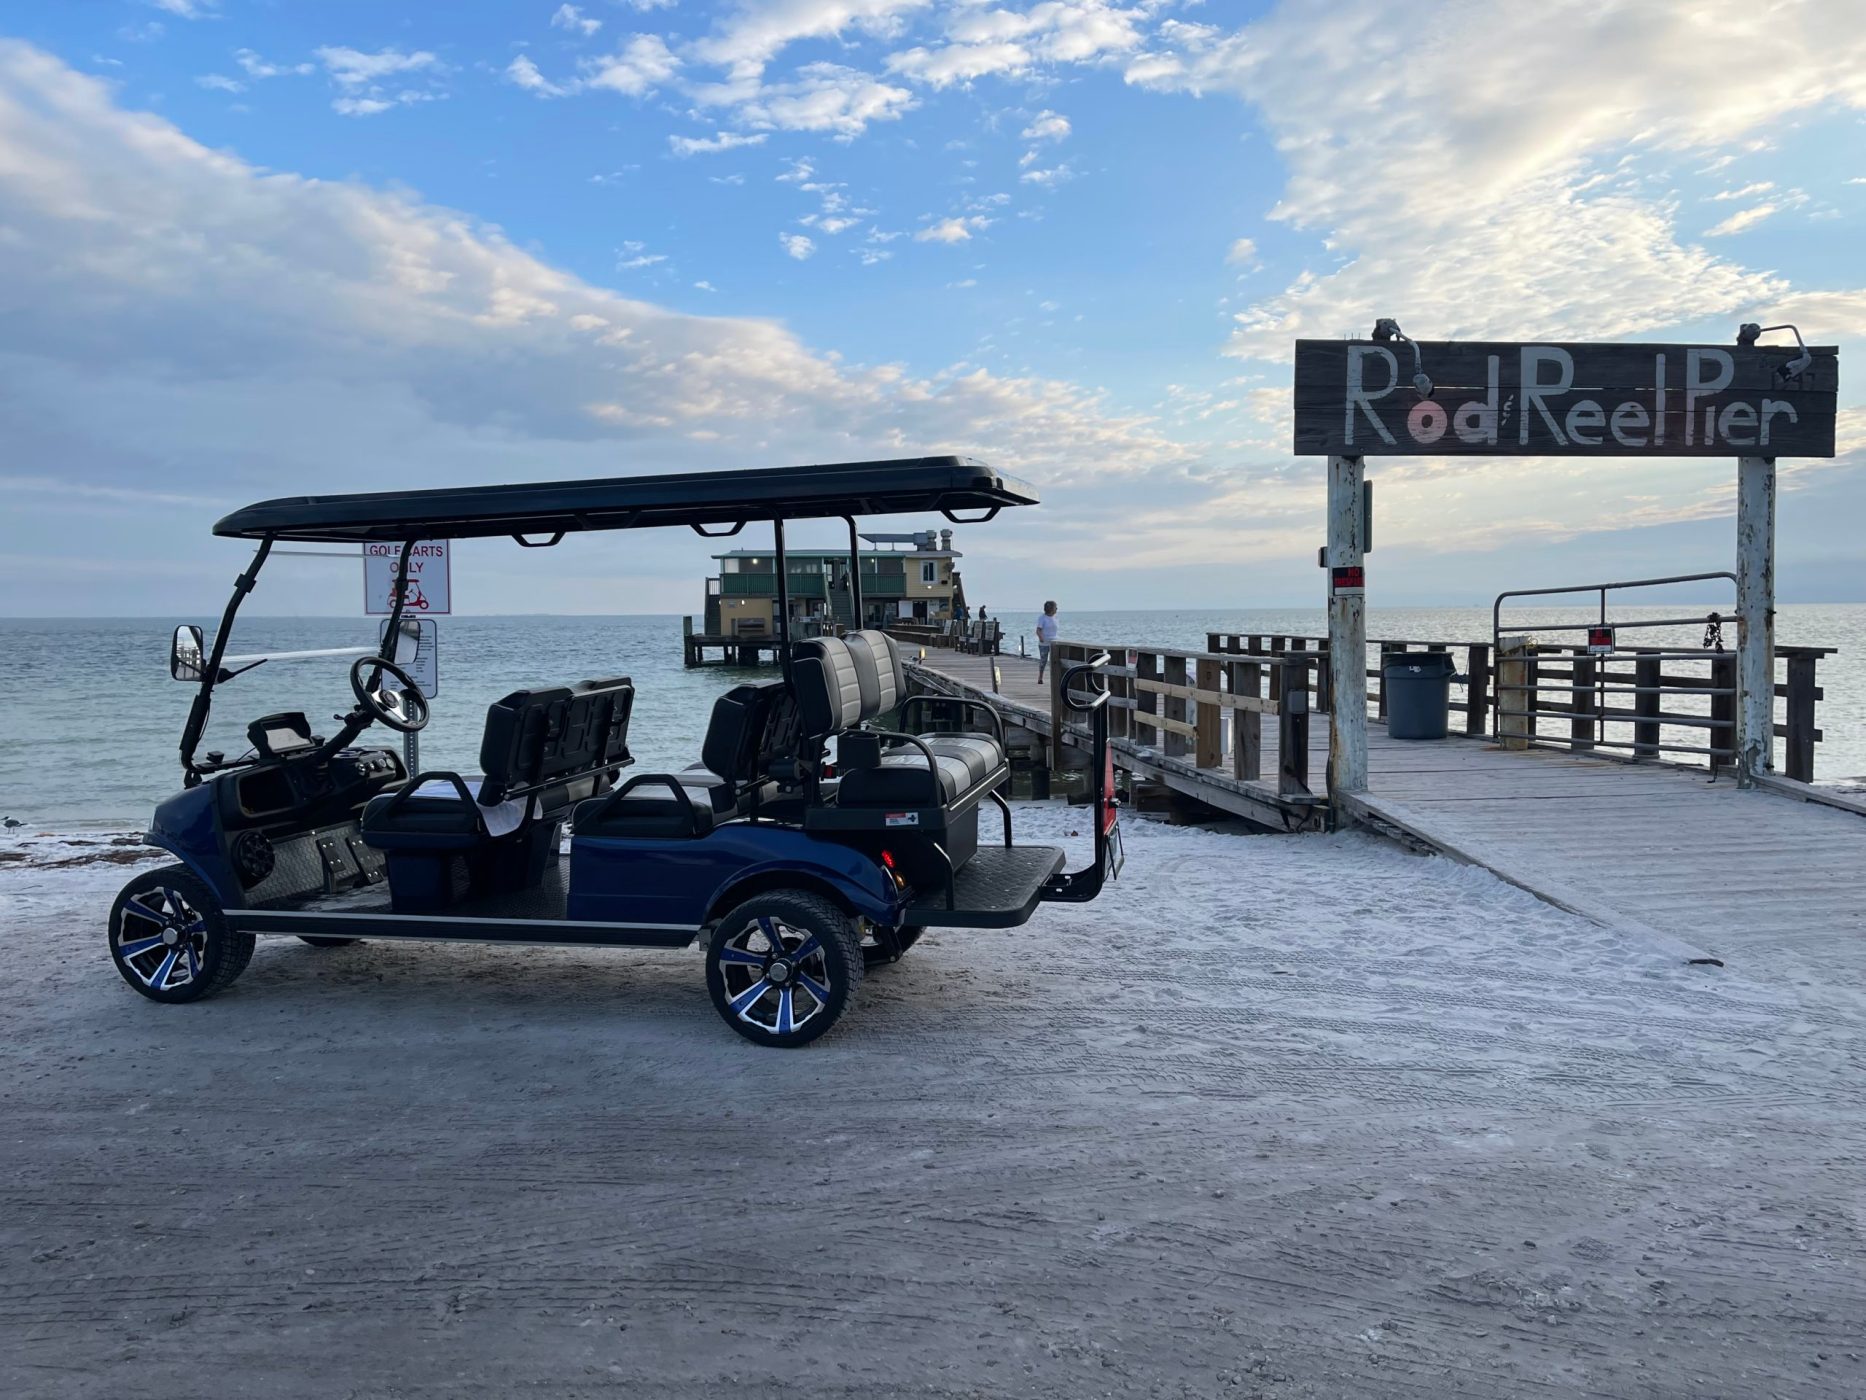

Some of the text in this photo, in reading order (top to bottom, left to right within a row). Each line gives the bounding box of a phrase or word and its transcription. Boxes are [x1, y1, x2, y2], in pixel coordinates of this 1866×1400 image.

[1345, 345, 1500, 445] Rod
[1520, 346, 1666, 446] Reel
[1685, 348, 1798, 446] Pier
[409, 546, 443, 557] ARTS
[390, 561, 423, 573] OLY
